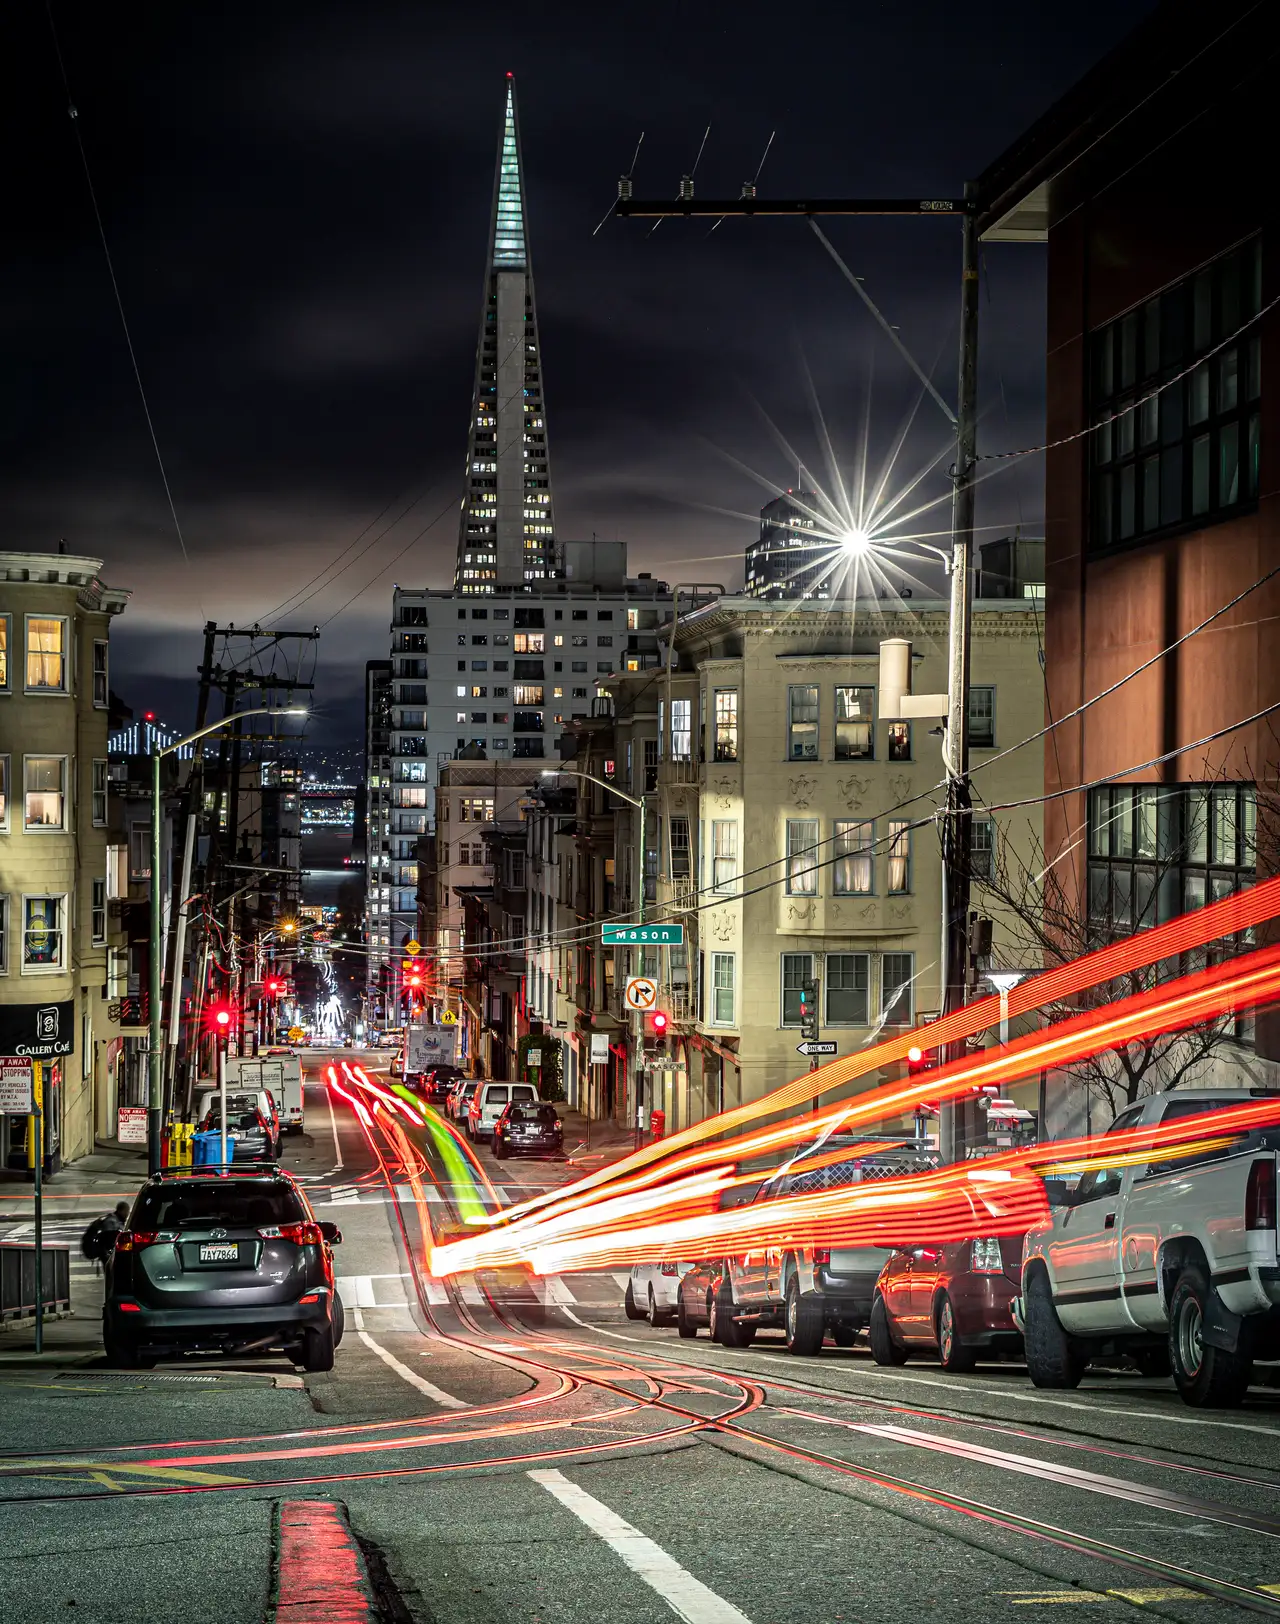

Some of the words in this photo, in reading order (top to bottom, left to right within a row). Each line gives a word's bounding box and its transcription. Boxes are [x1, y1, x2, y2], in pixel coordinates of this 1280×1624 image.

[616, 929, 669, 940] Mason
[16, 1044, 53, 1055] GALLERY
[4, 1068, 30, 1078] STOPPING
